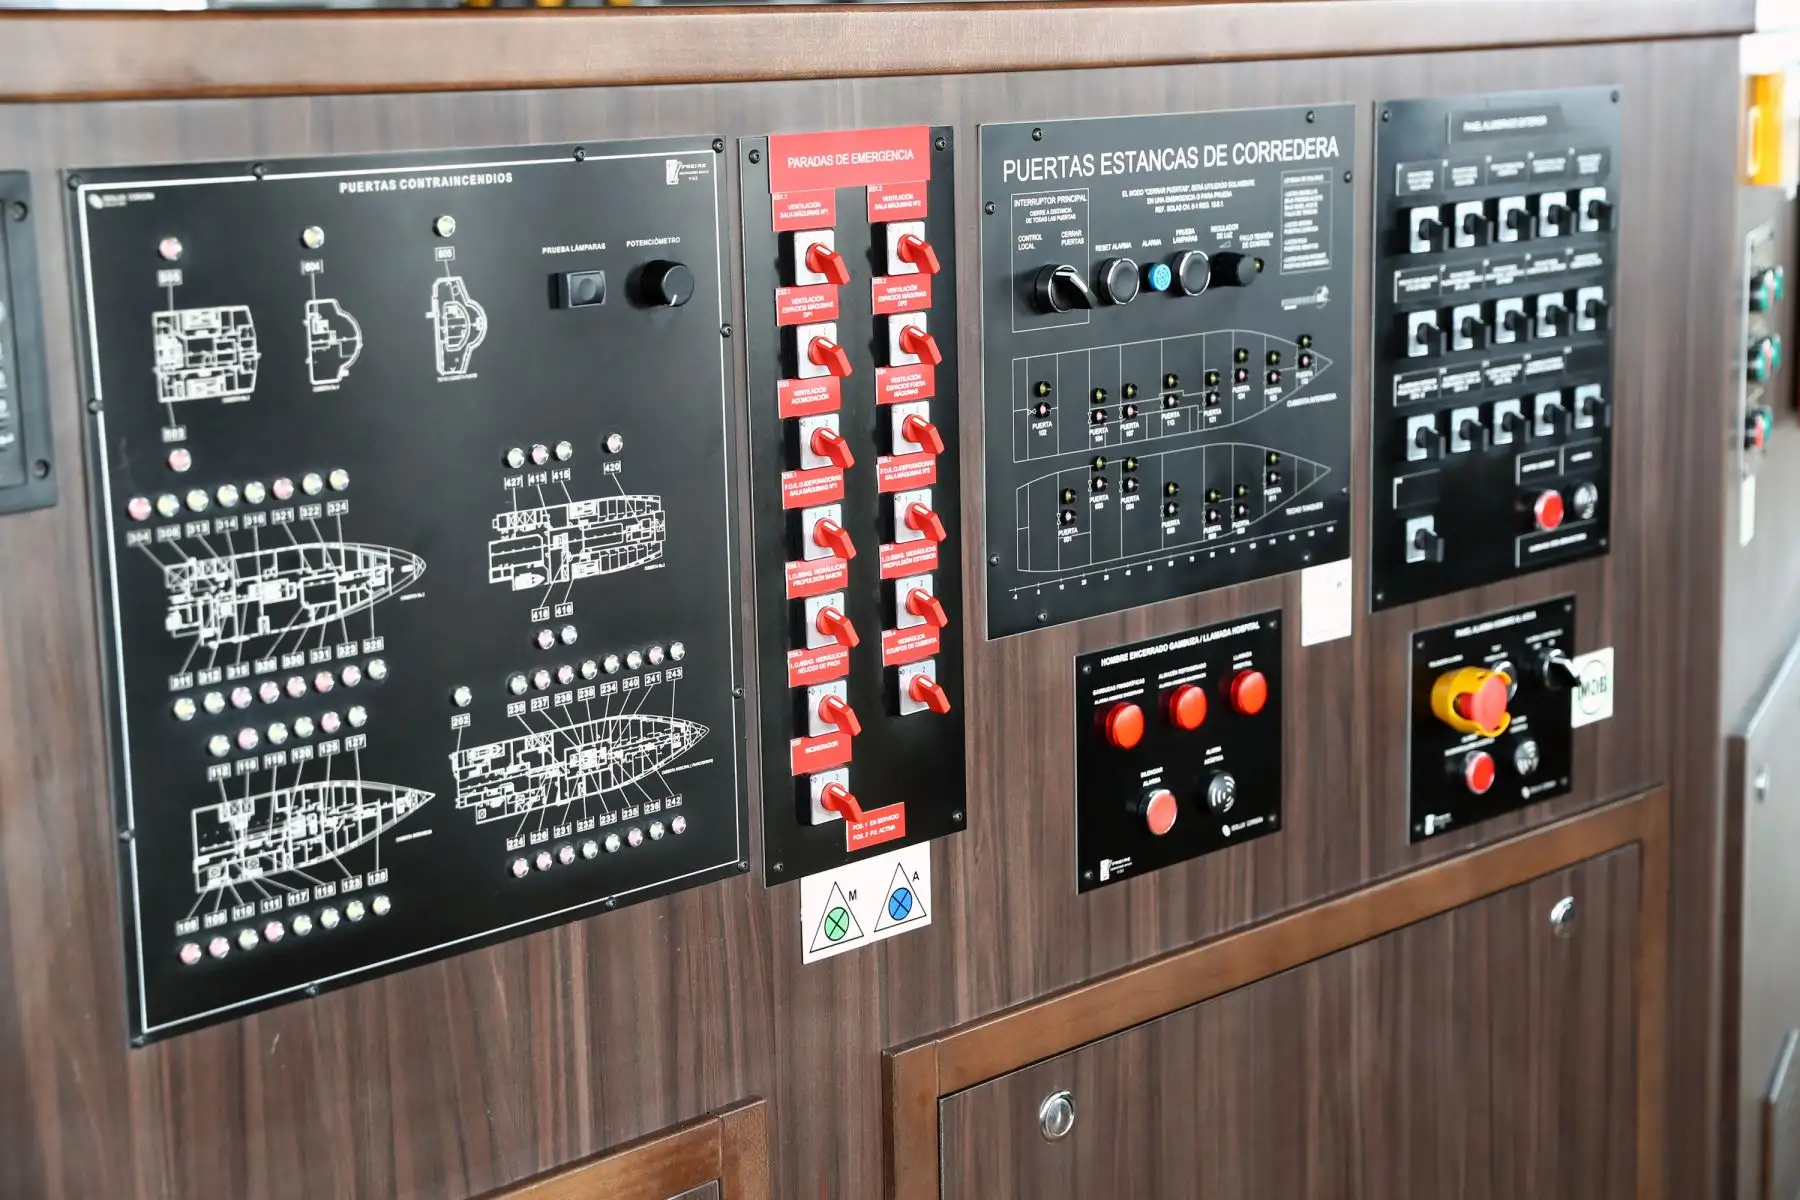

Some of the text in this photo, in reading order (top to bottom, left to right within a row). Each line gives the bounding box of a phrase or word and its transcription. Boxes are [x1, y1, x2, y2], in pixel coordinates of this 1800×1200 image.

[788, 149, 914, 168] PARADAS DE EMERGENCIA
[1004, 135, 1339, 183] PUERTAS ESTANCAS DE CORREDERA
[340, 173, 513, 193] PUERTAS CONTRAINCENDIOS
[1129, 189, 1144, 197] MODO
[1014, 194, 1087, 207] INTERRUPTOR PRINCIPAL
[1146, 197, 1154, 205] EN
[1154, 196, 1165, 204] UNA
[1165, 194, 1195, 203] EMERGENCIA
[1201, 192, 1214, 200] PARA
[1029, 209, 1046, 217] CIERRE
[1050, 207, 1072, 215] DISTANCIA
[1033, 215, 1047, 223] TODAS
[1057, 213, 1076, 221] PUERTAS
[1176, 227, 1195, 236] PRUEBA
[1210, 223, 1239, 233] REGULADOR
[1018, 233, 1042, 243] CONTROL
[1061, 229, 1082, 239] CERRAR
[1216, 231, 1233, 240] DE LUZ
[626, 237, 681, 248] POTENCIÓMETRO
[1018, 242, 1035, 251] LOCAL
[1061, 237, 1085, 246] PUERTAS
[1095, 241, 1132, 252] RESET ALARMA
[1142, 238, 1162, 248] ALARMA
[542, 242, 606, 254] PRUEBA LÁMPARAS
[1161, 411, 1180, 420] PUERTA
[1203, 408, 1222, 417] PUERTA
[1032, 421, 1052, 430] PUERTA
[1120, 421, 1139, 432] PUERTA
[1090, 427, 1108, 437] PUERTA
[1089, 494, 1109, 504] PUERTA
[1120, 495, 1140, 504] PUERTA
[1161, 519, 1180, 528] PUERTA
[1058, 527, 1078, 536] PUERTA
[1101, 652, 1128, 667] HOMBRE
[1129, 643, 1168, 660] ENCERRADO
[1169, 636, 1199, 651] GAMBUZA
[1203, 628, 1232, 643] LLAMADA
[1232, 621, 1260, 635] HOSPITAL
[869, 819, 877, 827] EN
[877, 813, 899, 824] SERVICIO
[878, 824, 896, 834] ACTIVA
[913, 871, 920, 882] A
[849, 889, 857, 902] M
